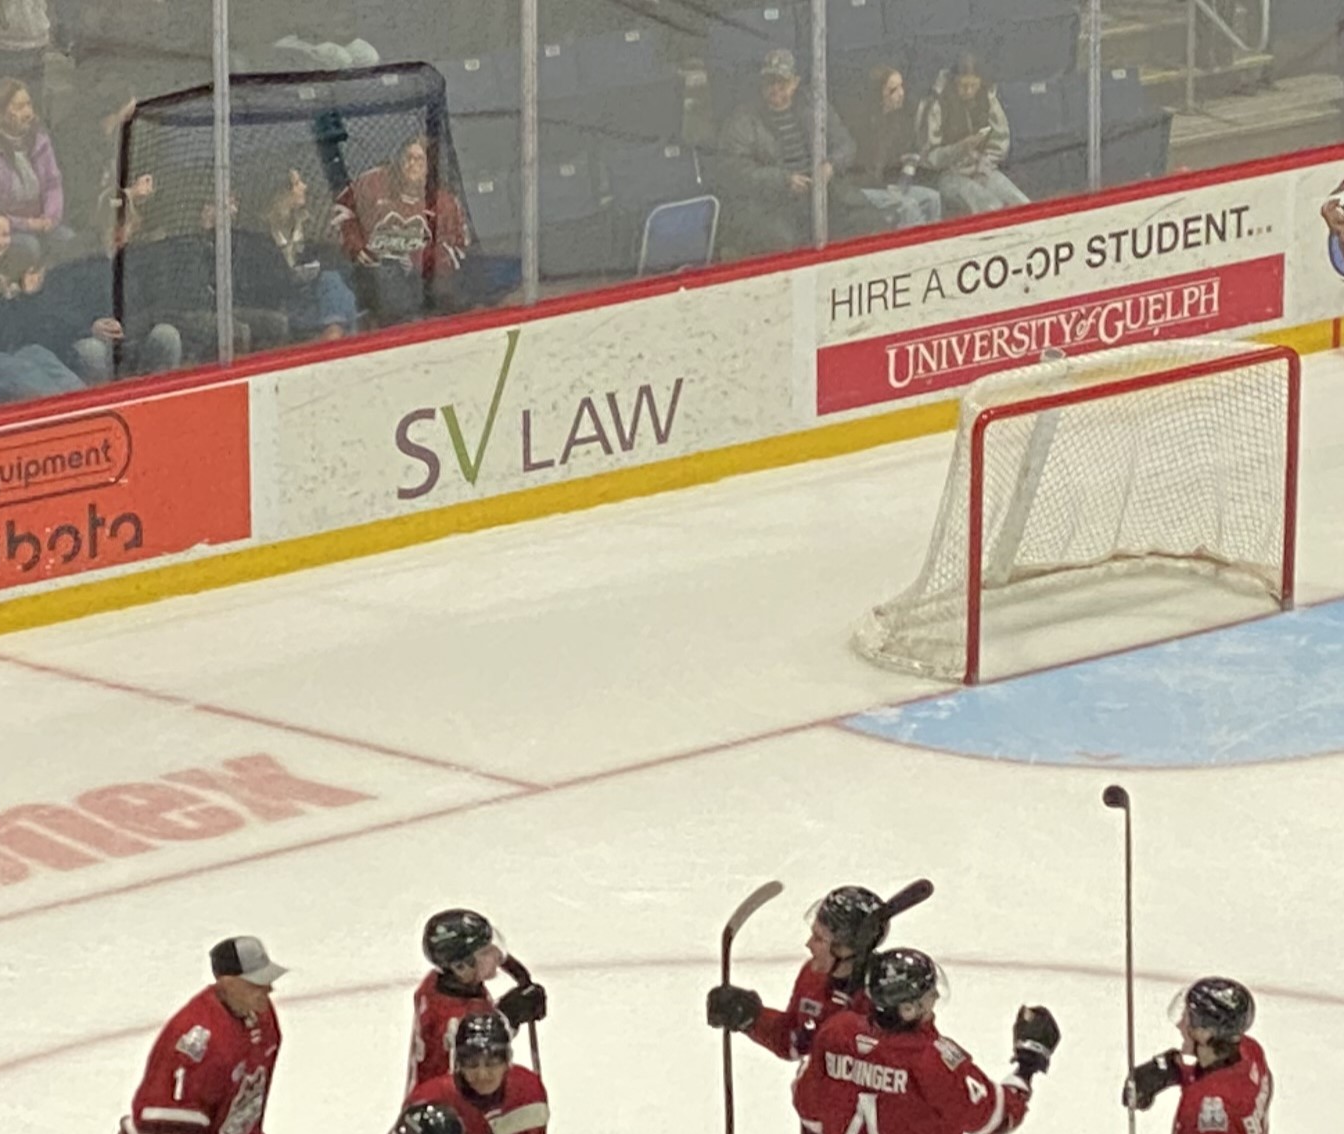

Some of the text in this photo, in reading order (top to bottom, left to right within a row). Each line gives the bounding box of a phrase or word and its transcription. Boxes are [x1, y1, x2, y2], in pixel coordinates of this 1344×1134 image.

[830, 272, 913, 322] HIRE
[922, 267, 946, 305] A
[956, 241, 1074, 296] CO-OP
[885, 310, 1078, 389] UNIVERSITY
[1098, 281, 1220, 345] GUELPH
[522, 377, 685, 473] LAW
[173, 1067, 185, 1101] 1
[965, 1075, 988, 1105] 4
